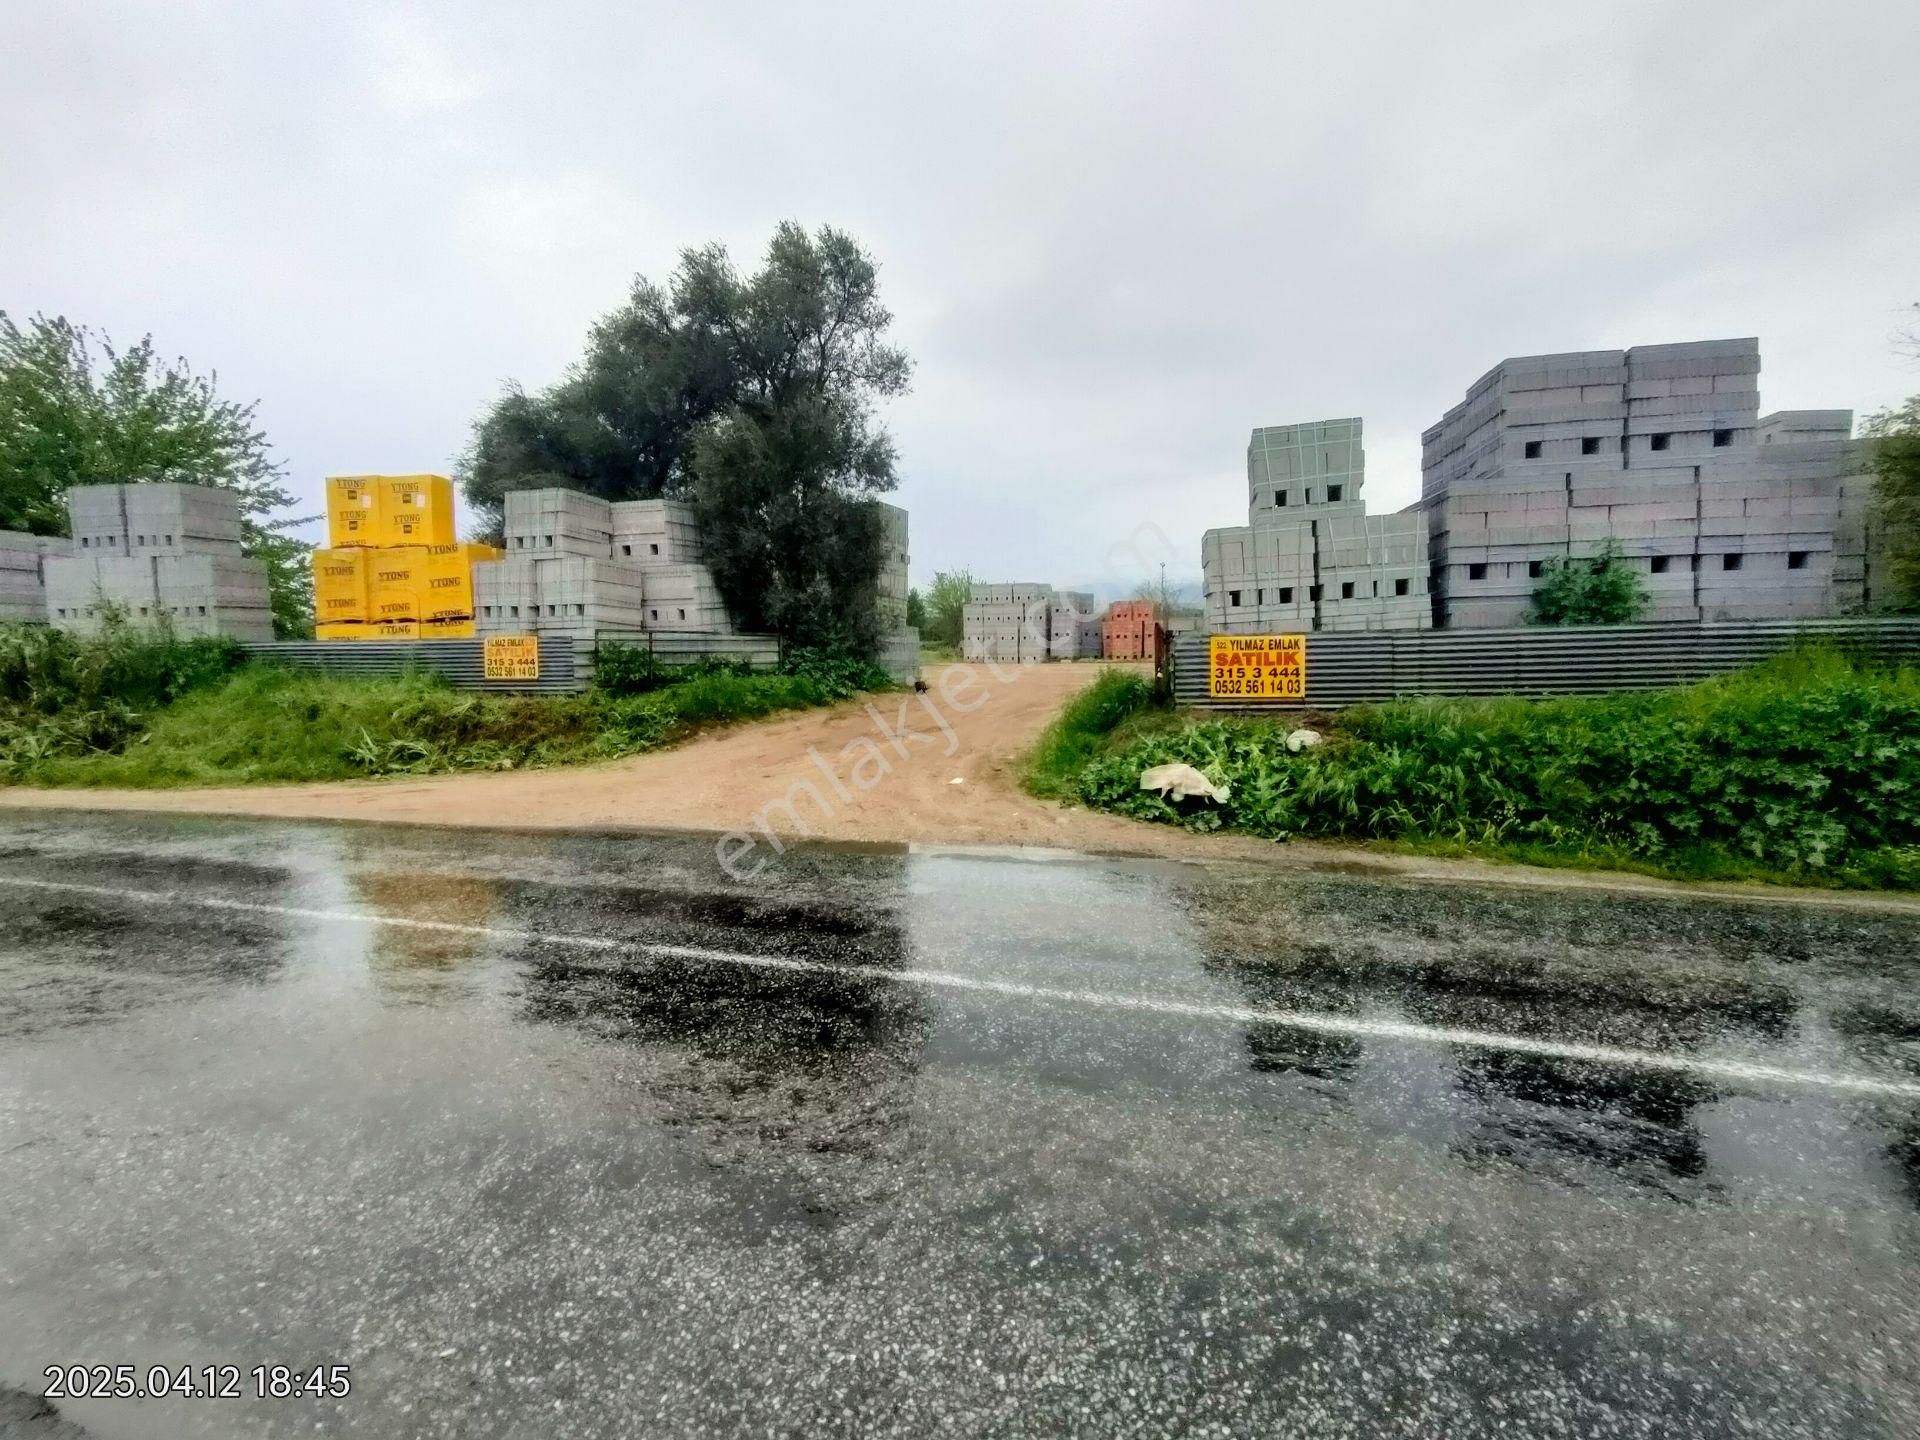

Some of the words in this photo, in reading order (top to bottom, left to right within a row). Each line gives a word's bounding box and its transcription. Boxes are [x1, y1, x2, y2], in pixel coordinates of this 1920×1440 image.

[336, 479, 366, 488] YTONG
[391, 482, 419, 492] YTONG
[339, 510, 367, 519] YTONG
[394, 513, 421, 523] YTONG
[427, 544, 458, 556] YTONG
[324, 566, 354, 577] YTONG
[378, 570, 410, 582] YTONG
[429, 576, 461, 588] YTONG
[327, 598, 356, 609] YTONG
[380, 603, 410, 613] YTONG
[379, 625, 410, 634] YTONG
[1230, 639, 1264, 651] YILMAZ
[1268, 639, 1300, 650] EMLAK
[487, 658, 505, 666] 315
[508, 658, 514, 666] 3
[517, 658, 536, 666] 444
[1215, 652, 1300, 666] SATILIK
[487, 666, 503, 677] 0532
[504, 666, 516, 677] 561
[518, 667, 526, 676] 14
[528, 666, 536, 677] 03
[1215, 668, 1245, 678] 315
[1252, 668, 1262, 678] 3
[1268, 667, 1300, 678] 444
[1215, 680, 1242, 693] 0532
[1246, 680, 1265, 693] 561
[1270, 680, 1283, 693] 14
[1287, 680, 1301, 693] 03
